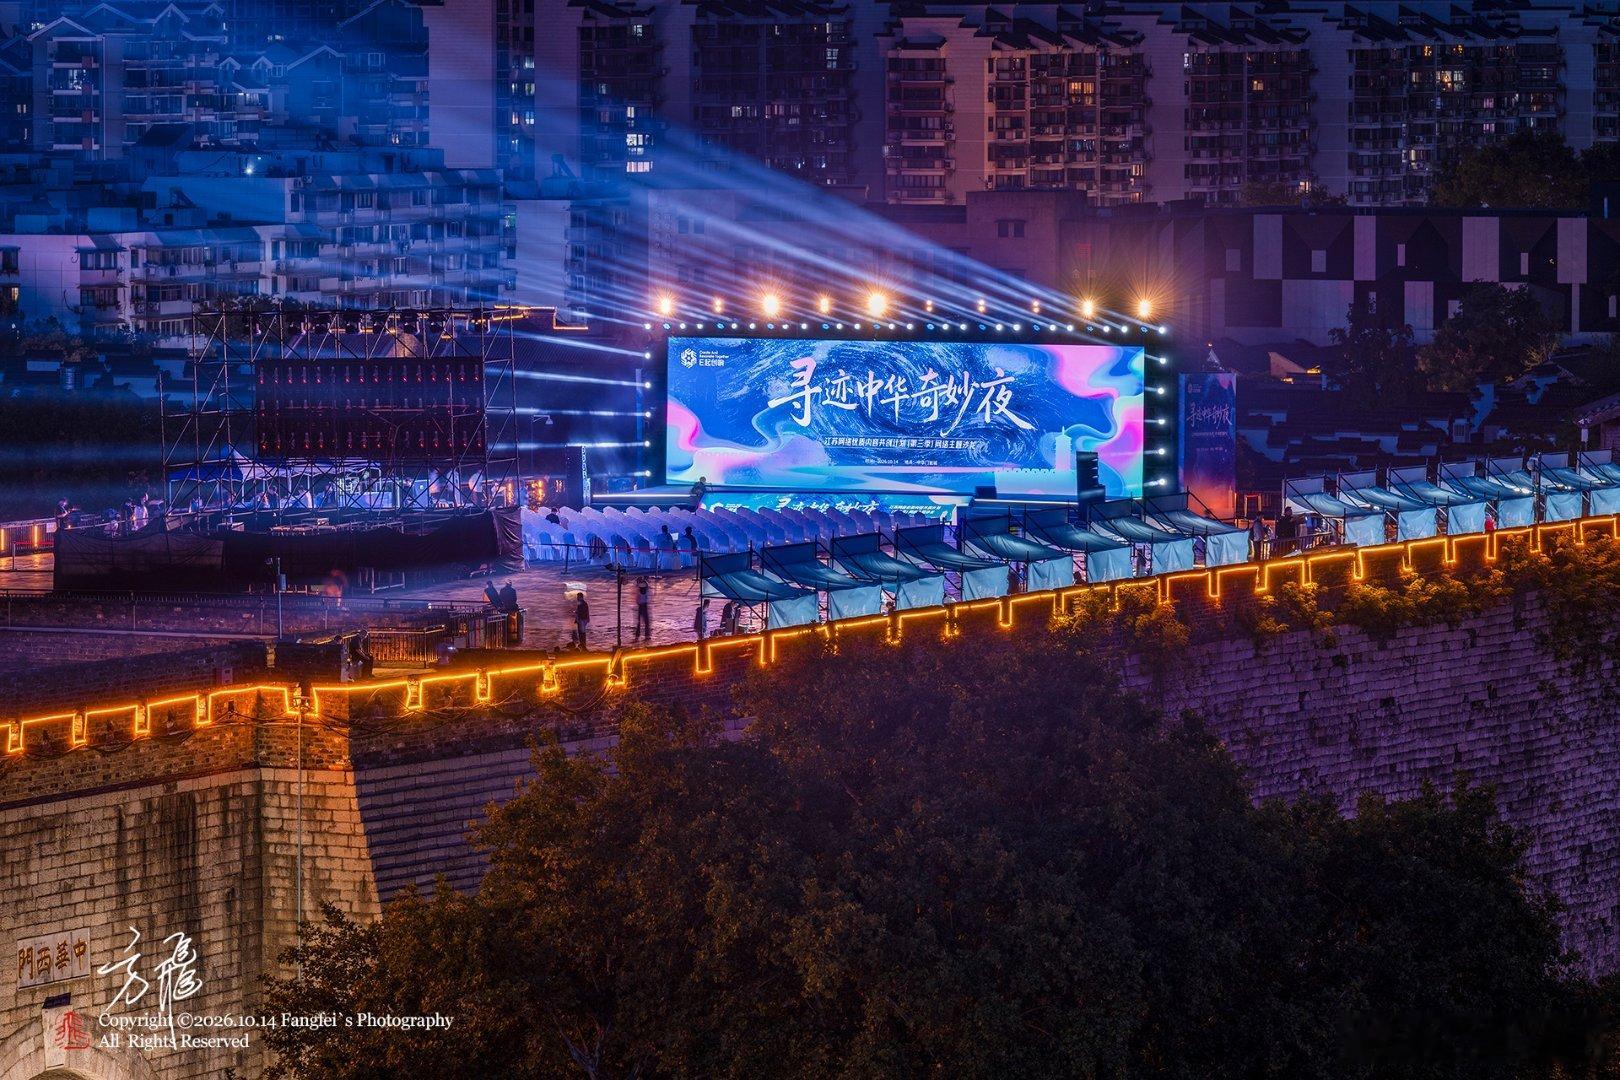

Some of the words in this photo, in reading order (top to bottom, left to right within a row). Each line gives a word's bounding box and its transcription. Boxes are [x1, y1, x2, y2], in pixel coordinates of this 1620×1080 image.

[768, 357, 1037, 437] 寻迹中华奇妙夜
